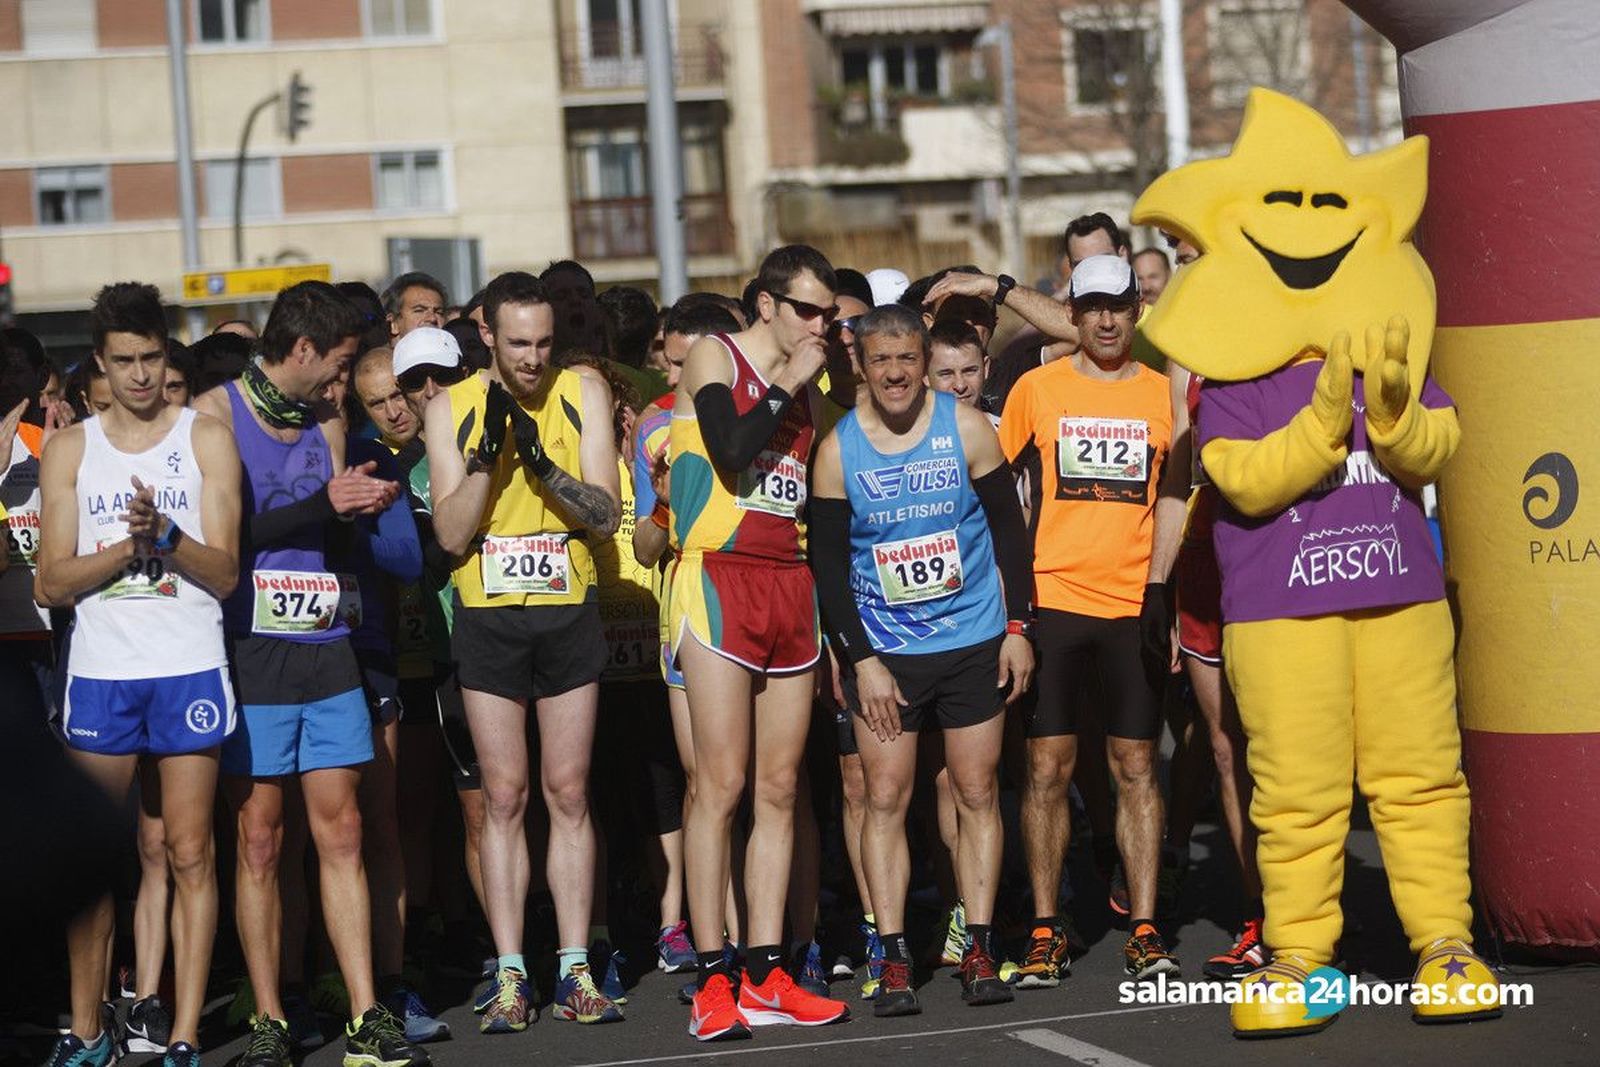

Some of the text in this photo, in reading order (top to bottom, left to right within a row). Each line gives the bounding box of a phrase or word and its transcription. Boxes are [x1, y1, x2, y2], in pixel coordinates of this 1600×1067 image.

[1061, 422, 1145, 441] bedunia
[1077, 439, 1129, 465] 212
[906, 457, 957, 474] COMERCIAL
[756, 471, 798, 502] 138
[907, 467, 961, 495] ULSA
[88, 495, 106, 516] LA
[868, 501, 955, 525] ATLETISMO
[875, 536, 957, 566] bedunia
[1529, 538, 1600, 564] PALA
[502, 554, 553, 578] 206
[895, 557, 945, 587] 189
[1287, 542, 1408, 588] AERSCYL
[255, 575, 338, 592] bedunia
[271, 592, 322, 618] 374
